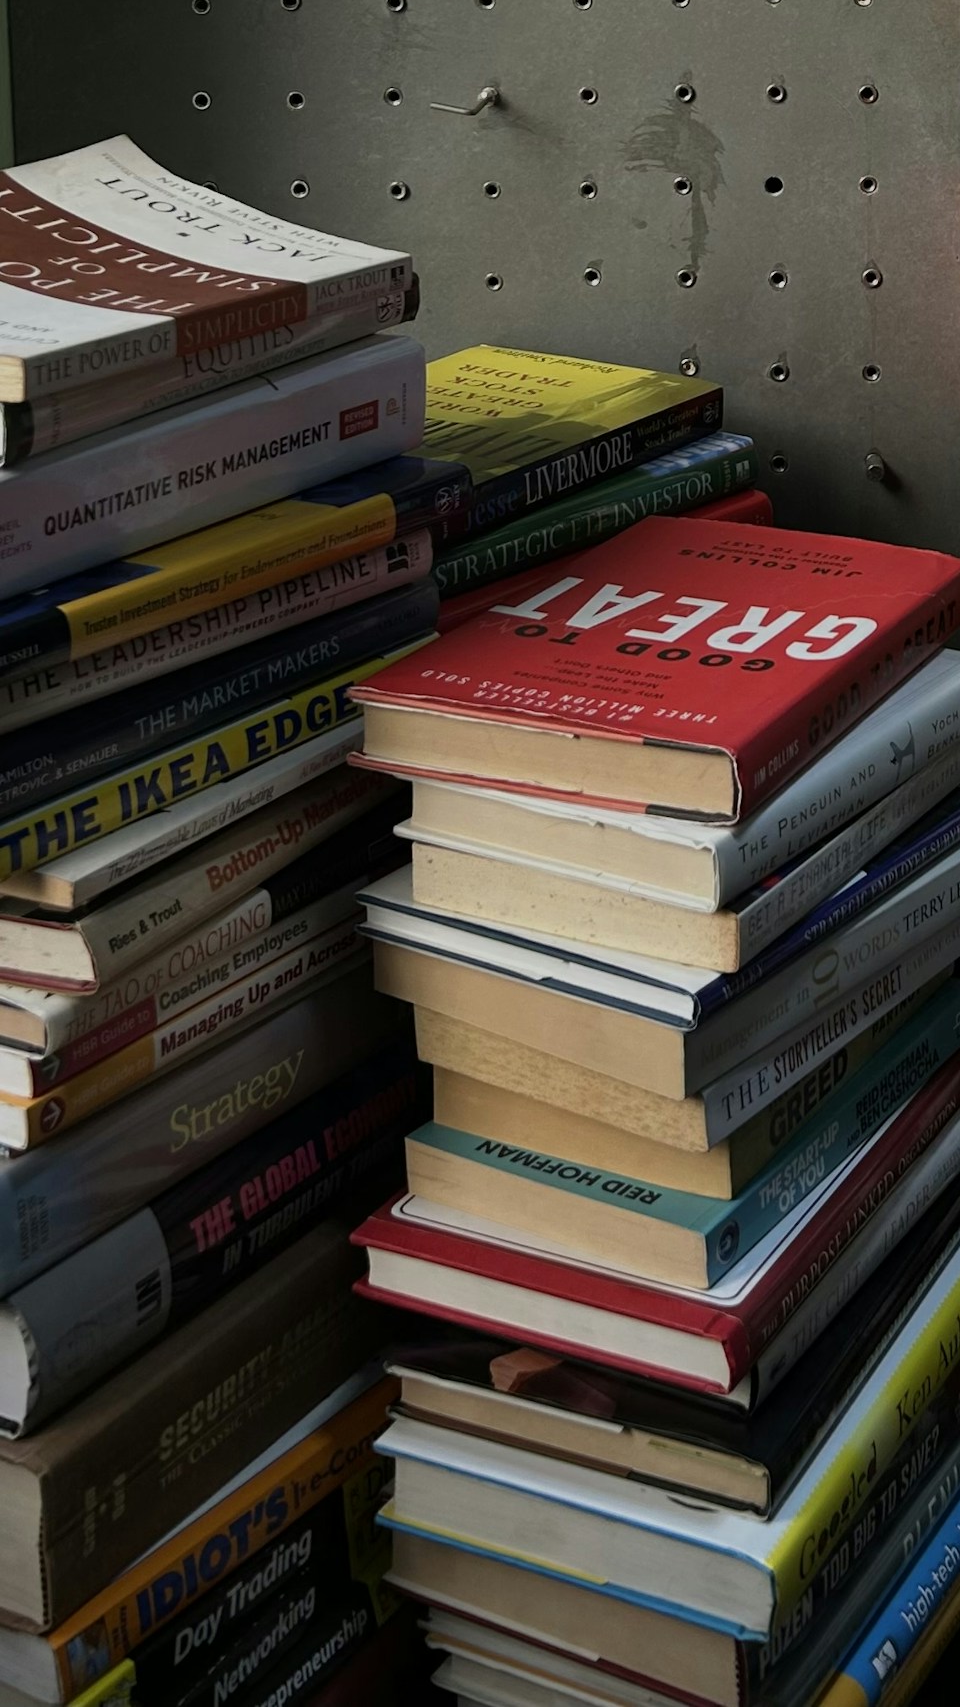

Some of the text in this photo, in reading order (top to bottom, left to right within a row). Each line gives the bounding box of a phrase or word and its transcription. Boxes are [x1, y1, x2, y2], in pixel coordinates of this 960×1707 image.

[44, 421, 331, 536] QUANTITATIVE RISK MANAGEMENT
[523, 433, 633, 506] LIVERMORE
[434, 472, 716, 591] STRATEGIC ETF INVESTOR
[489, 574, 878, 661] GREAT
[515, 624, 775, 672] GOOD TO
[135, 636, 341, 739] THE MARKET MAKERS
[2, 682, 357, 873] THE IKEA EDGE
[206, 813, 303, 891] Bottom-Up
[903, 896, 947, 932] TERRY
[171, 1049, 304, 1152] Strategy
[474, 1138, 663, 1204] REID HOFFMAN
[894, 1373, 933, 1427] Ken
[137, 1486, 287, 1632] IDIOT'S
[800, 1442, 877, 1580] Googled
[173, 1528, 312, 1666] Day Trading
